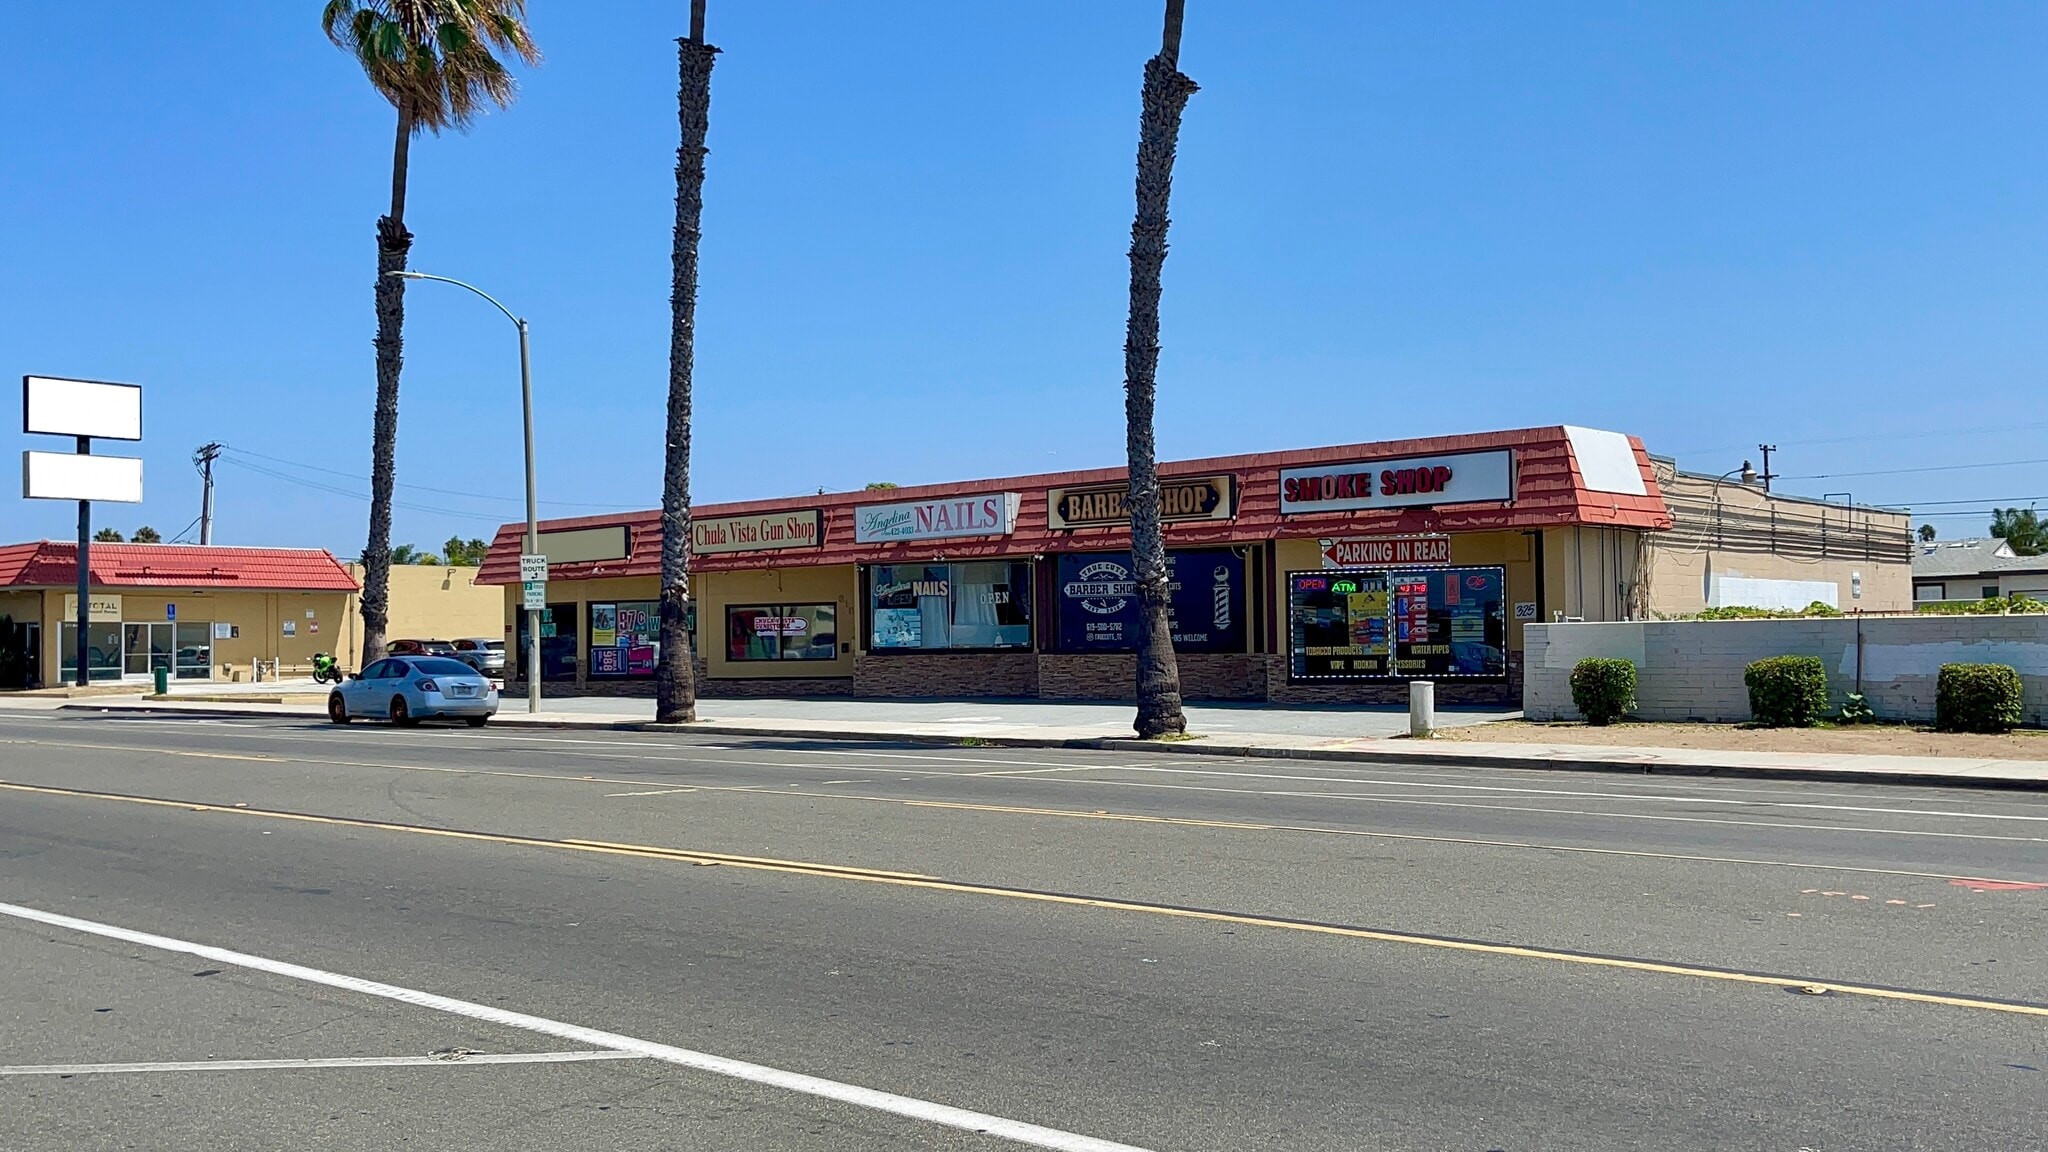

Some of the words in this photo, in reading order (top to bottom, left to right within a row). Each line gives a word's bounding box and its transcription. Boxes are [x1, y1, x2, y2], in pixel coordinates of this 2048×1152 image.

[1284, 472, 1372, 502] SMOKE
[1380, 466, 1452, 496] SHOP
[1068, 491, 1131, 520] BARBE
[861, 510, 911, 535] Angelina
[914, 499, 998, 533] NAILS
[695, 524, 726, 546] Chula
[729, 521, 757, 543] Vista
[761, 519, 784, 541] Gun
[786, 517, 815, 544] Shop
[1336, 542, 1393, 562] PARKING
[1396, 541, 1410, 561] IN
[1414, 541, 1447, 560] REAR
[1082, 563, 1103, 577] TRUE
[1105, 564, 1126, 576] CUTS
[913, 580, 949, 597] NAILS
[1070, 584, 1109, 594] BARBER
[1298, 580, 1325, 590] OPEN
[1331, 583, 1356, 592] ATM
[980, 591, 1009, 604] OPEN
[1516, 604, 1535, 617] 325
[1183, 633, 1208, 641] WELCOME
[1305, 647, 1331, 655] TOBACCO
[1333, 646, 1363, 655] PRODUCTS
[1411, 645, 1432, 655] WATER
[1433, 644, 1450, 654] PIPES
[1330, 660, 1345, 669] VAPE
[1353, 660, 1378, 669] HOOKAH
